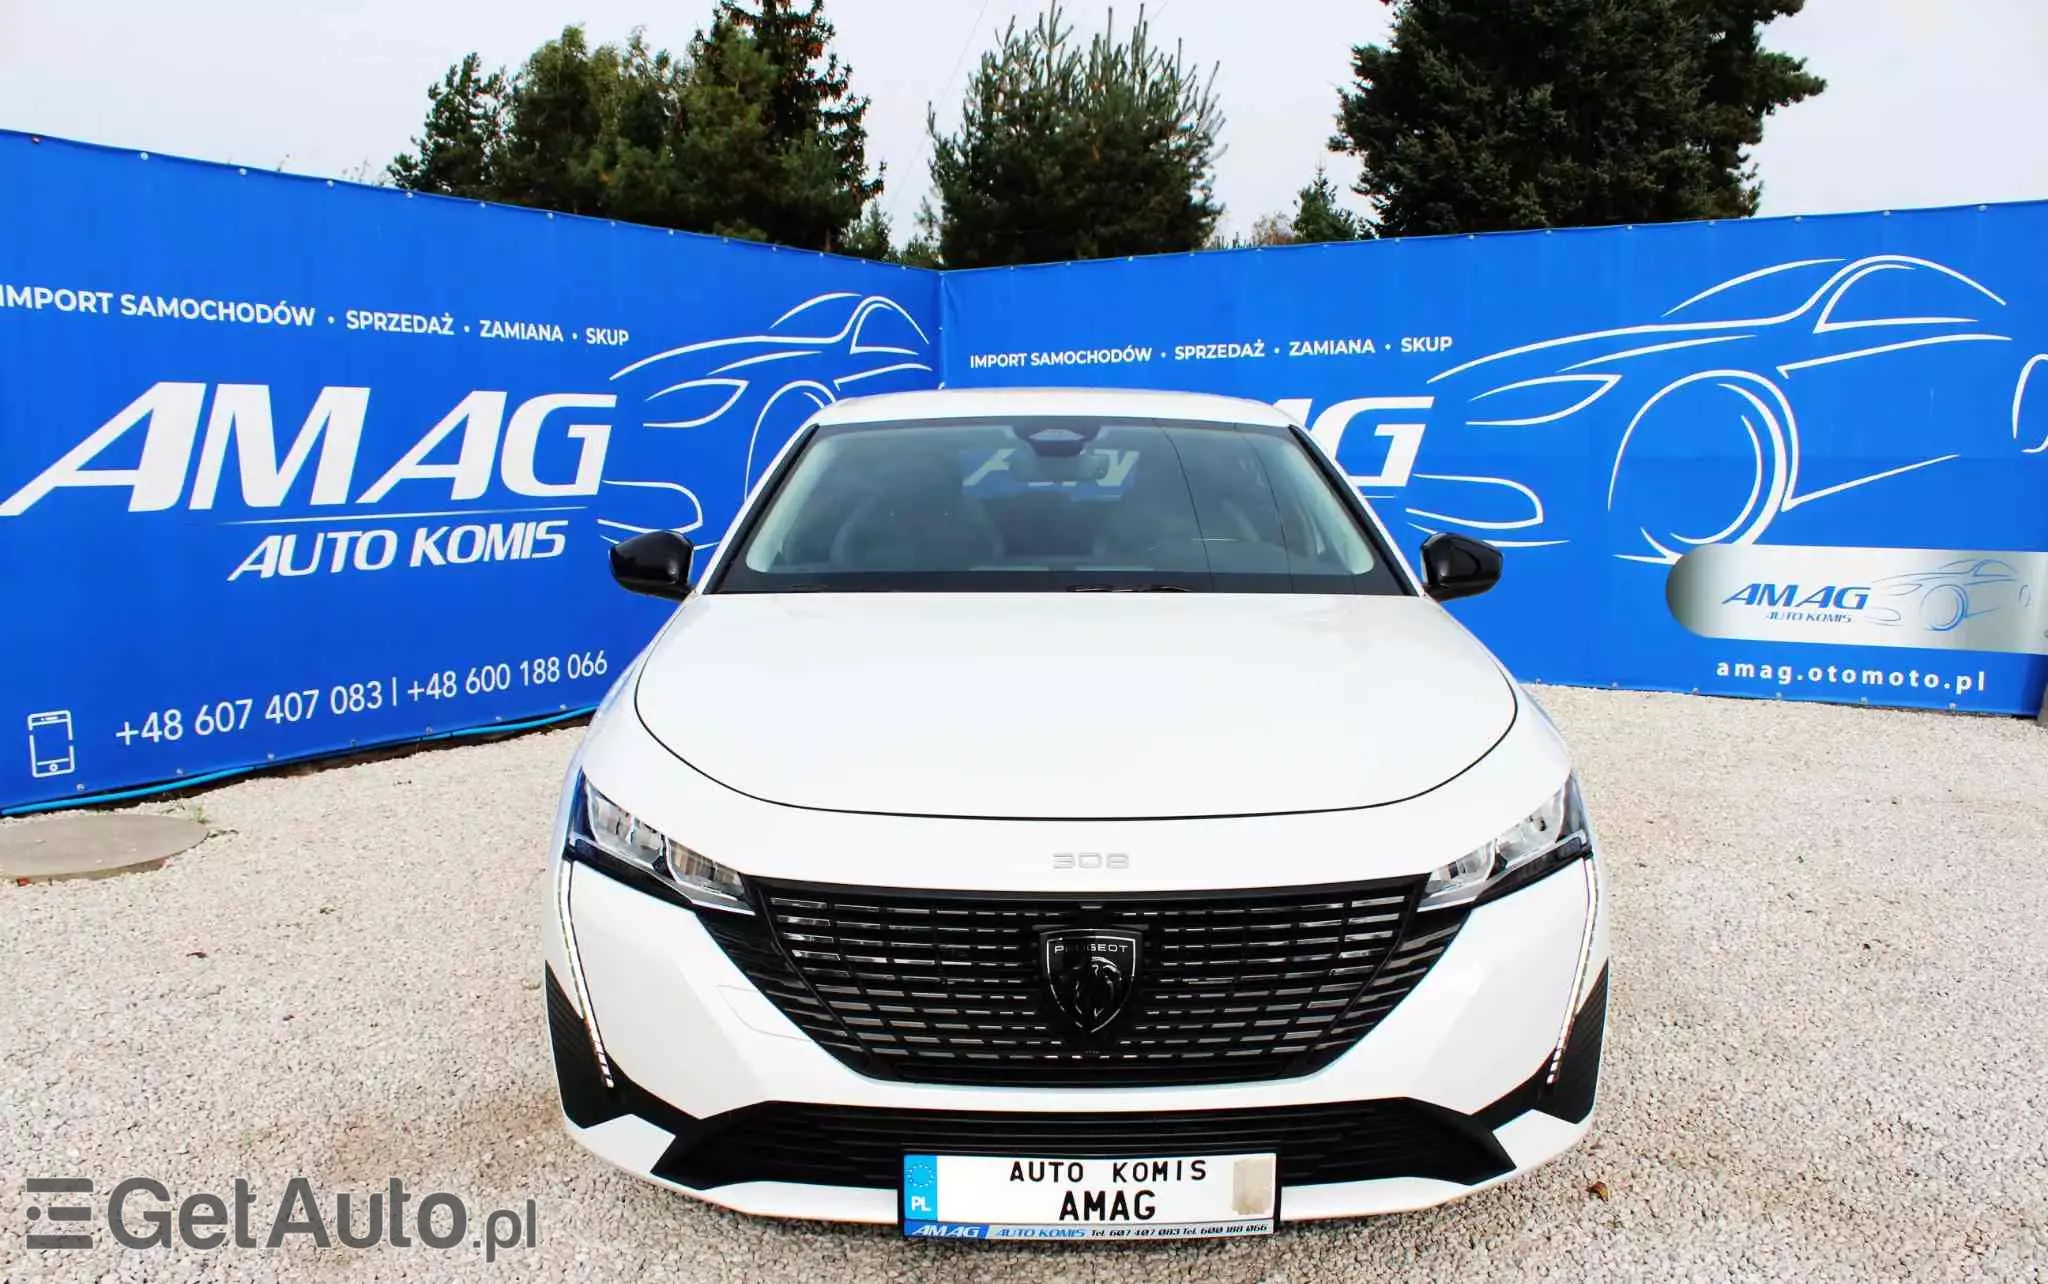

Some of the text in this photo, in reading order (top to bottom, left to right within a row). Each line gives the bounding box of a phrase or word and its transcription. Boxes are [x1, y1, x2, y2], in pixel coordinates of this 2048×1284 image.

[0, 283, 629, 346] IMPORT SAMOCHODÓW SPRZEDAŻ ZAMIANA SKUP
[970, 335, 1453, 368] IMPORT SAMOCHODÓW SPRZEDAŻ ZAMIANA SKUP
[0, 381, 617, 516] AMAG
[227, 519, 569, 581] AUTO KOMIS
[1721, 583, 1871, 610] AMAG
[1716, 661, 1986, 694] amag.otomoto.pl
[115, 650, 608, 746] +48 607 407 083 +48 600 188 066
[1052, 853, 1129, 869] 308
[1010, 1160, 1207, 1183] AUTO KOMIS
[911, 1196, 931, 1212] PL
[1059, 1190, 1156, 1221] AMAG
[912, 1224, 1086, 1238] AMAG AUTO KOMIS
